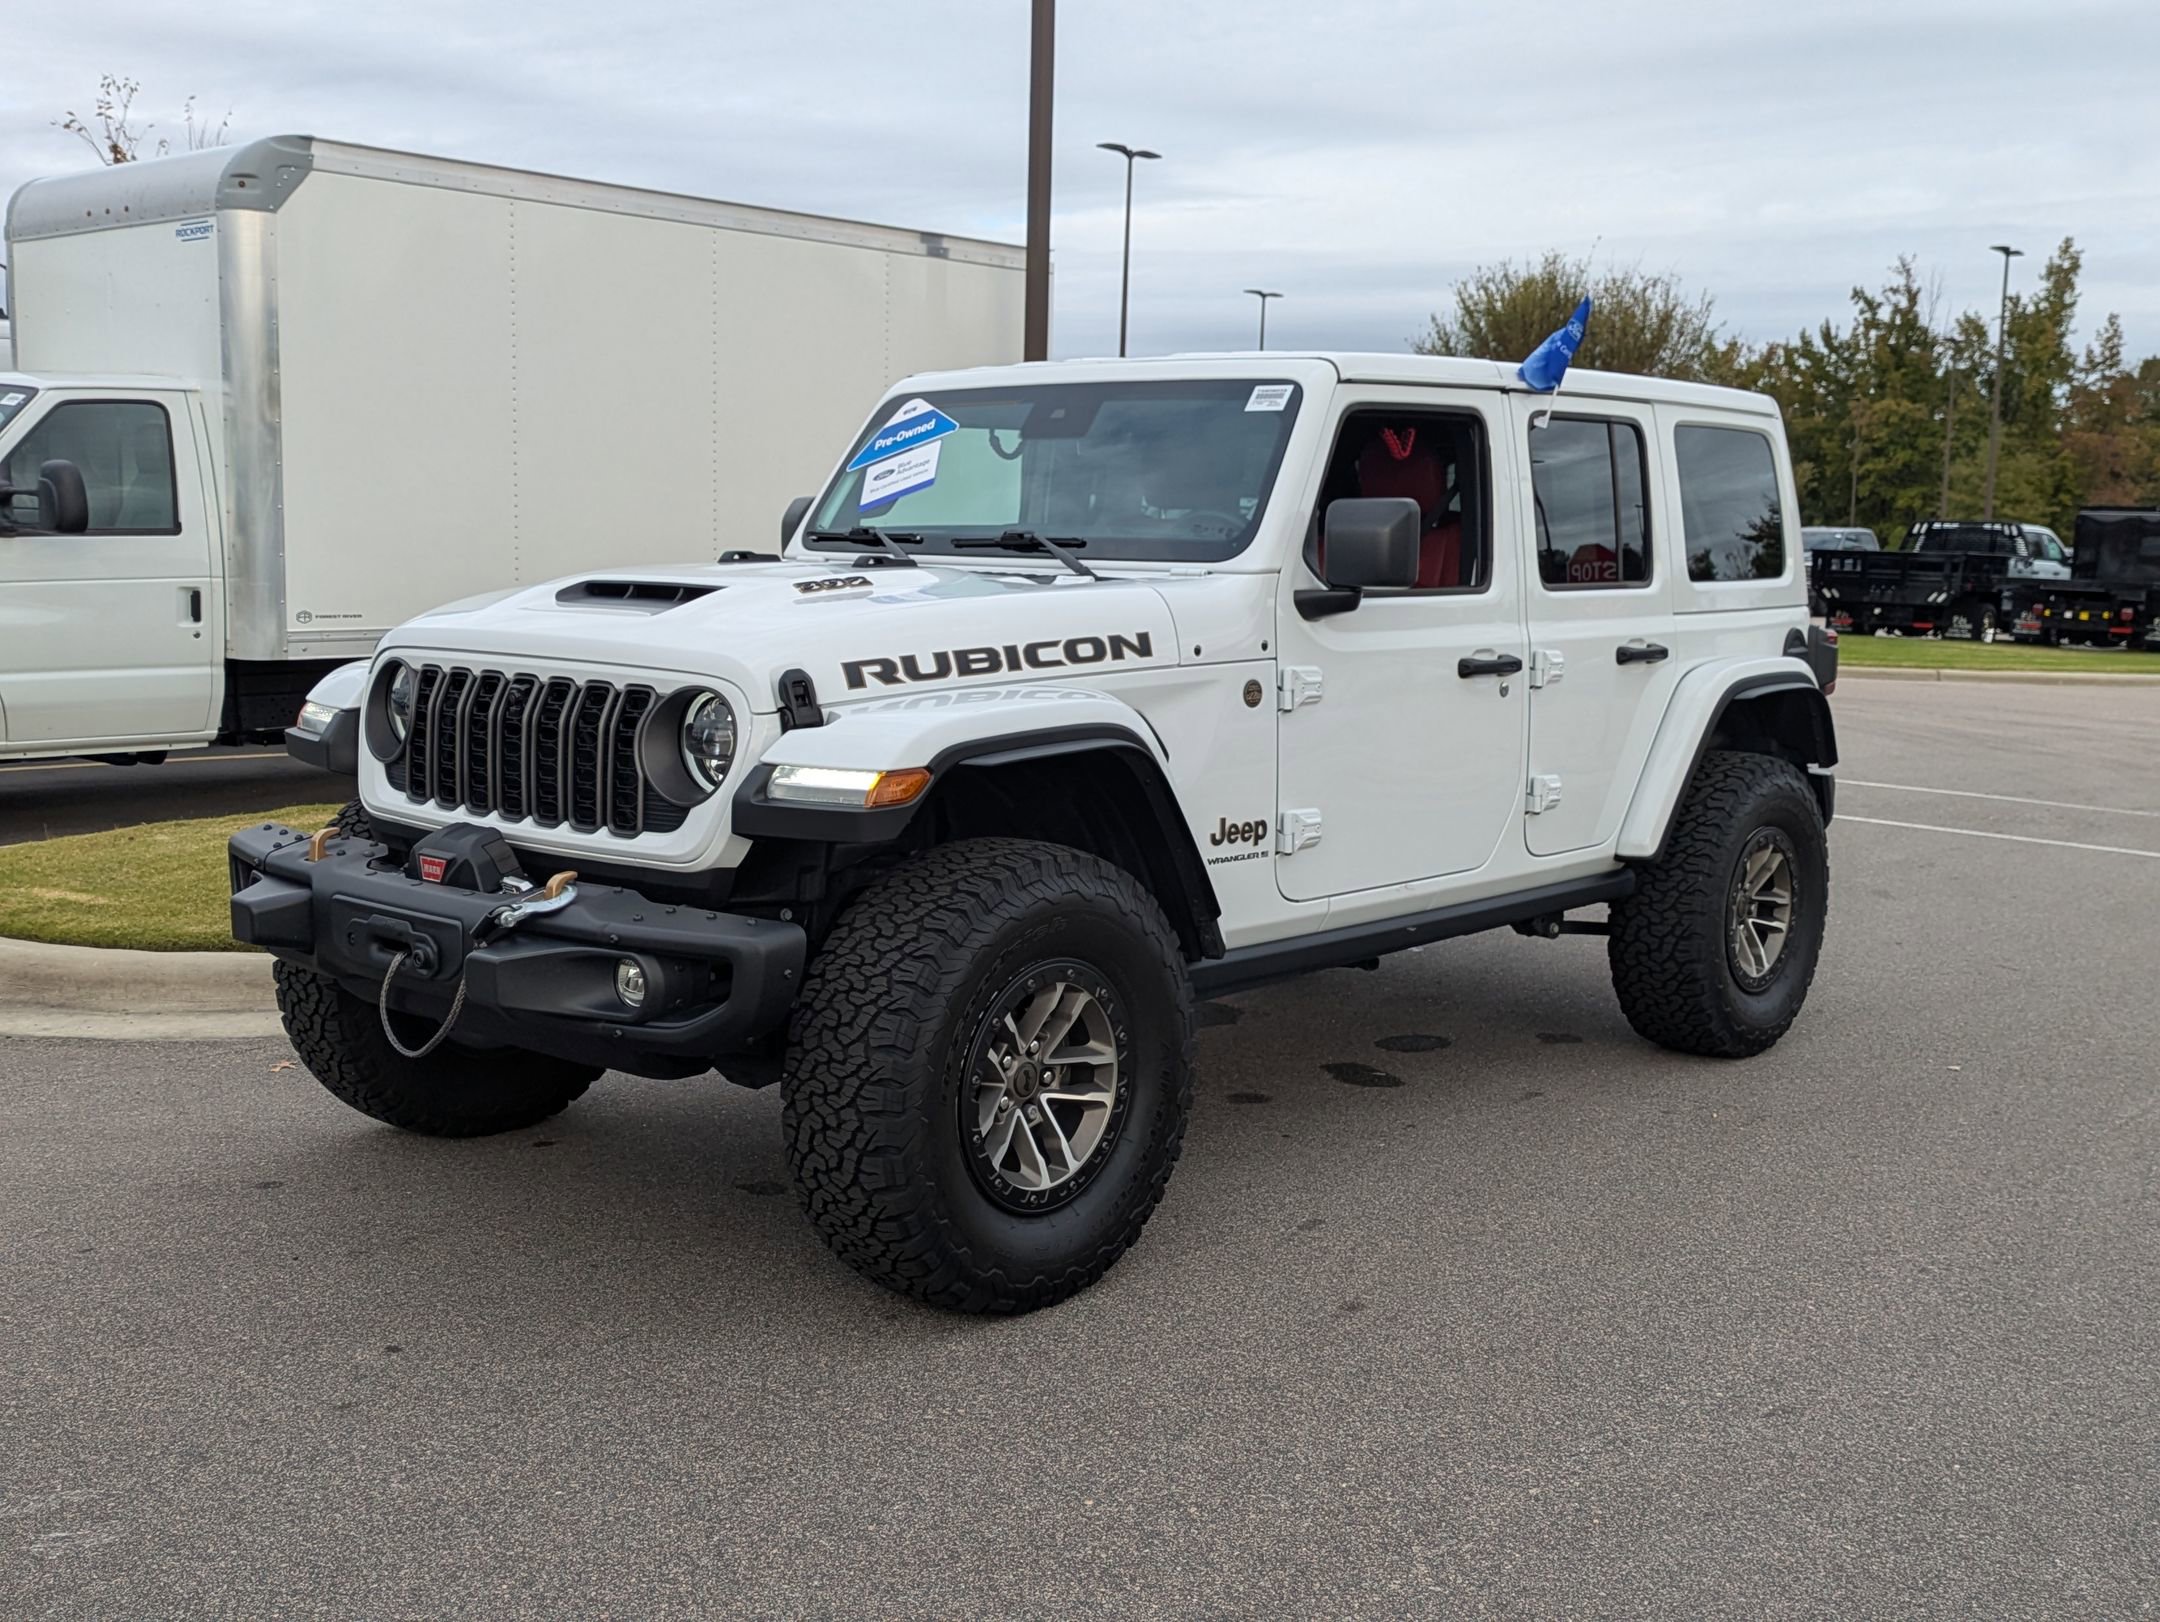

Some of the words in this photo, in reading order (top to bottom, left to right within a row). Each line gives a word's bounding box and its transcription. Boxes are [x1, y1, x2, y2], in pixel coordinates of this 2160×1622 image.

[175, 224, 215, 238] ROCKPORT
[874, 418, 936, 451] Pre-Owned
[840, 631, 1153, 690] RUBICON
[1209, 817, 1268, 847] Jeep
[1207, 851, 1260, 866] WRANGLER
